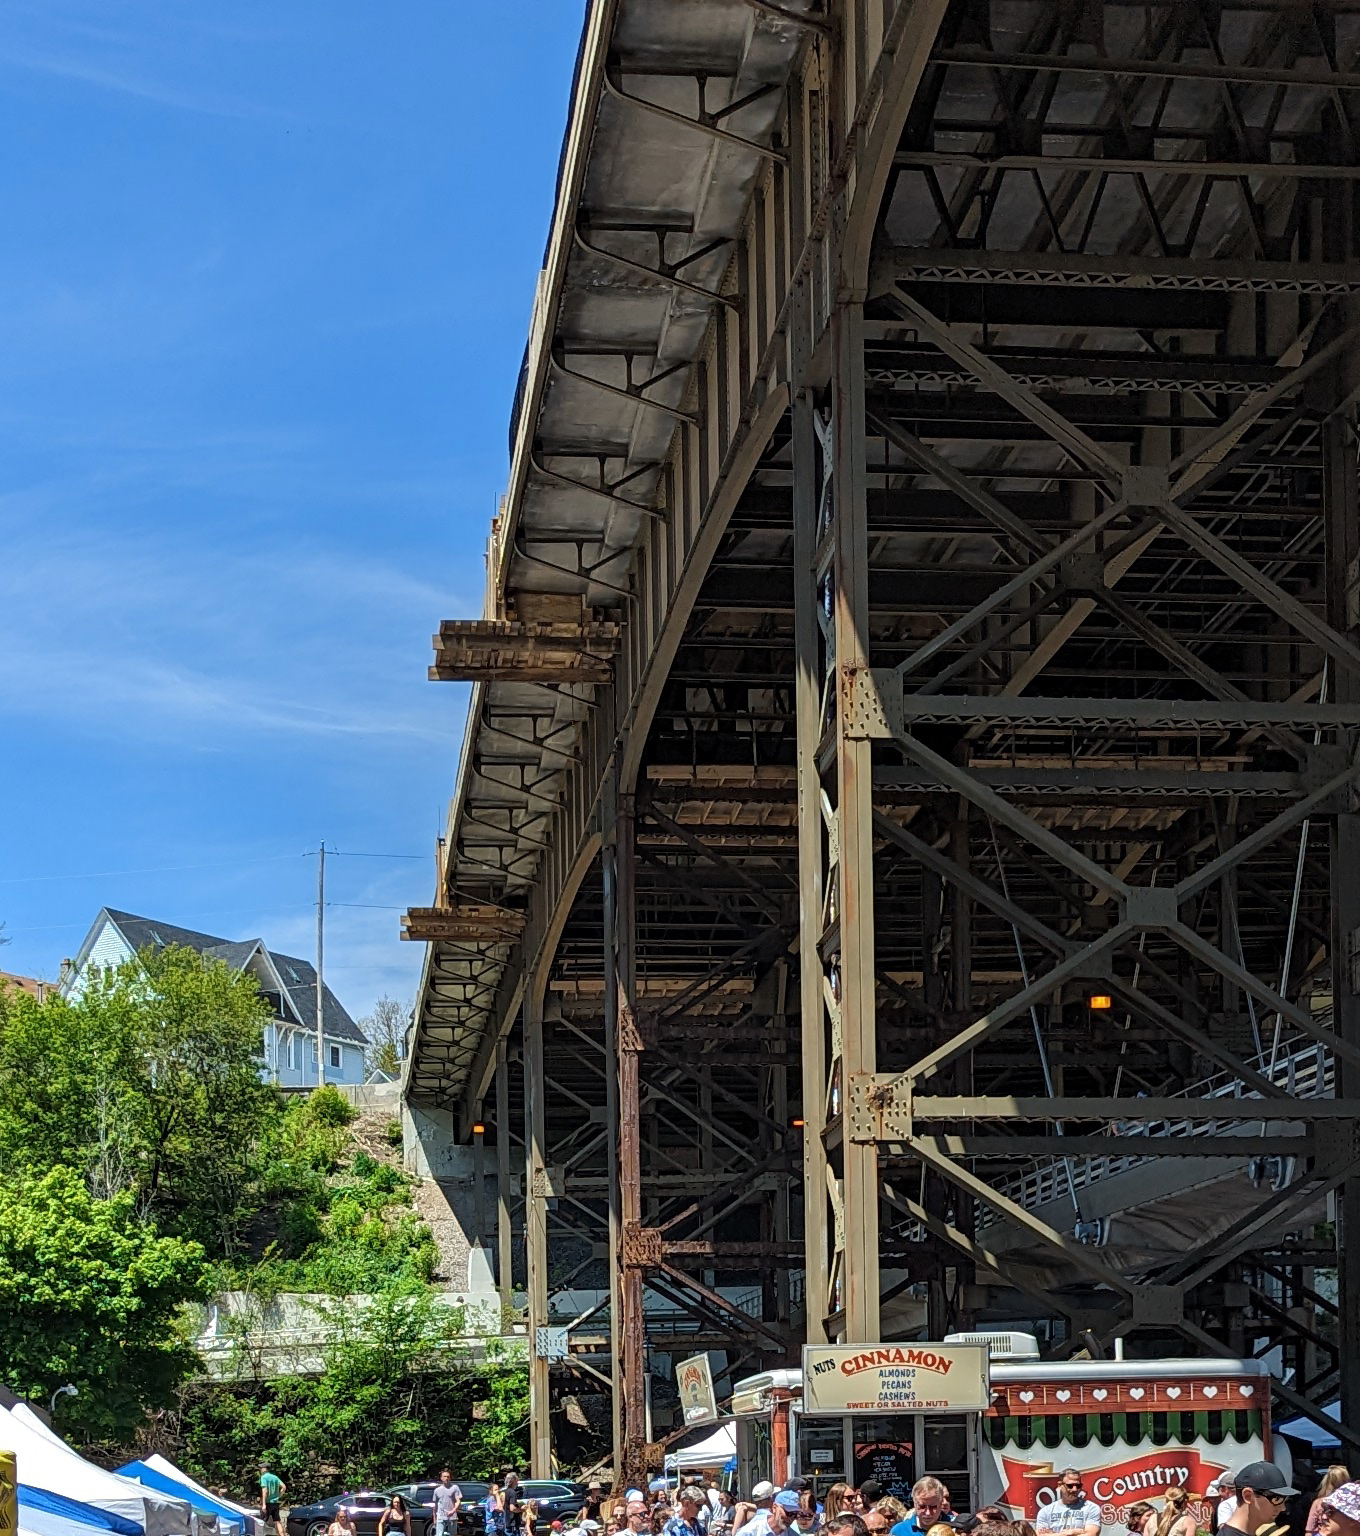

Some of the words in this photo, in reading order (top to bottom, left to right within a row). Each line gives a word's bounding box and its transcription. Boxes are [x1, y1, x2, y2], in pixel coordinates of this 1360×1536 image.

[813, 1358, 836, 1376] NUTS
[840, 1348, 953, 1376] CINNAMON
[878, 1369, 916, 1379] ALMONDS
[881, 1380, 912, 1390] PECANS
[878, 1391, 916, 1401] CASHEWS
[891, 1401, 924, 1409] SALTED
[926, 1400, 949, 1408] NUTS
[1092, 1464, 1189, 1502] Country
